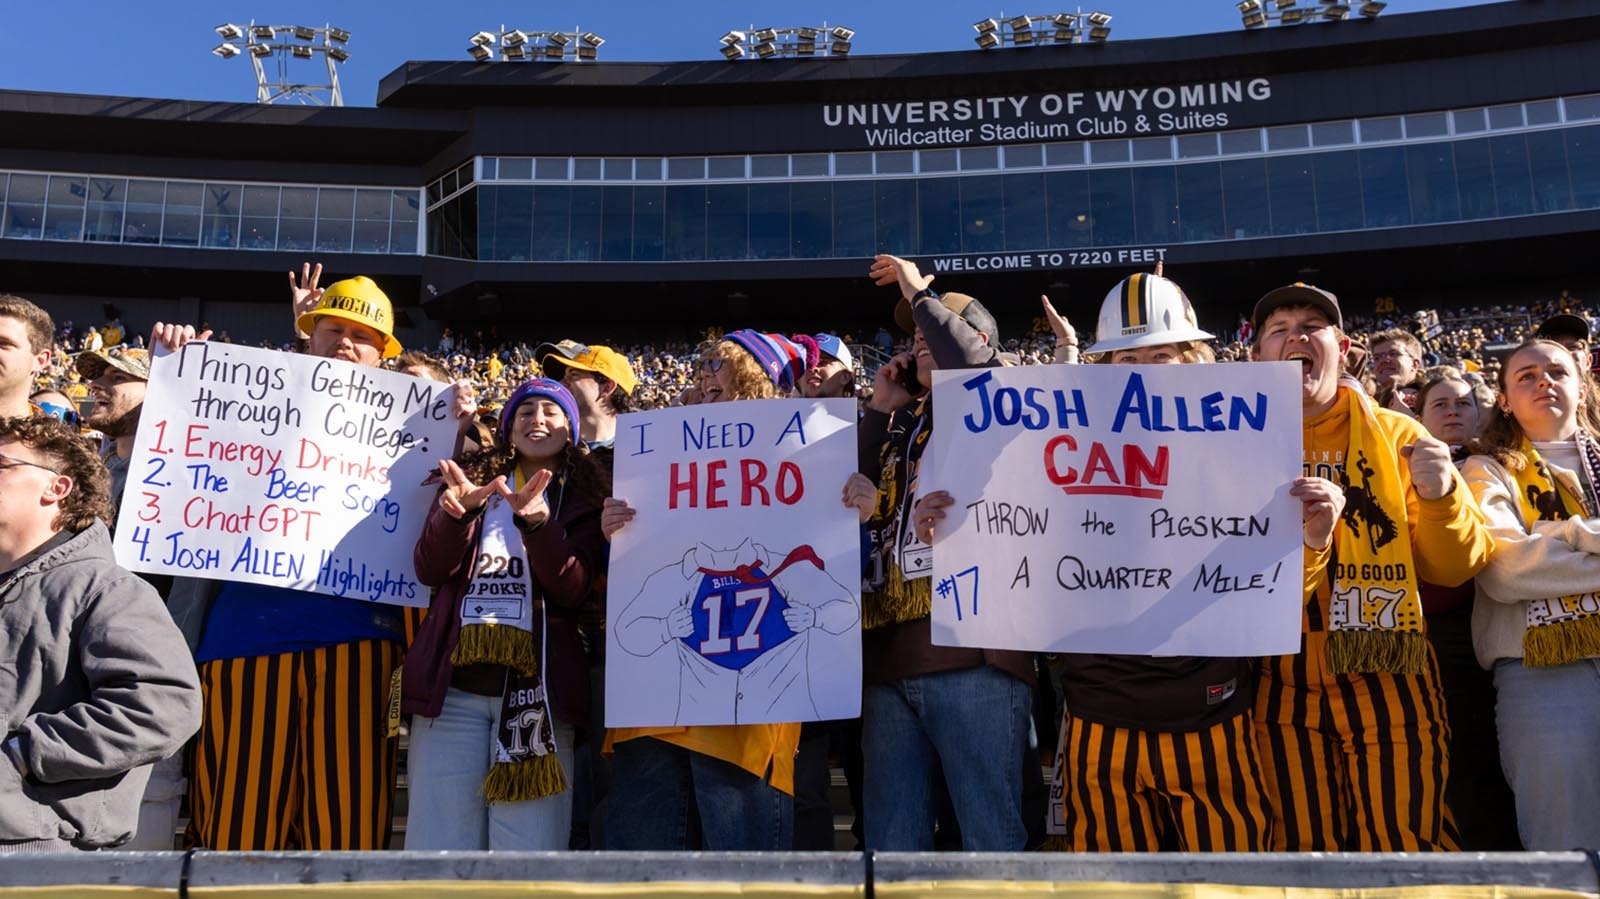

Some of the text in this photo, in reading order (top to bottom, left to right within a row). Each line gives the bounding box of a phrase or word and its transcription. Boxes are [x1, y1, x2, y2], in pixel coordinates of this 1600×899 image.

[823, 78, 1272, 126] UNIVERSITY OF WYOMING
[865, 112, 1229, 146] Wildcatter Stadium Club & Suites
[934, 249, 1168, 272] WELCOME TO 7220 FEET
[326, 296, 384, 323] WYOMING
[177, 341, 447, 421] Things Getting Me
[962, 370, 1268, 434] JOSH ALLEN
[192, 388, 430, 457] through College:
[631, 411, 807, 456] I NEED A
[148, 420, 391, 485] 1. Energy Drinks
[1043, 433, 1169, 488] CAN
[143, 458, 401, 533] 2. The Beer Song
[669, 458, 805, 510] HERO
[137, 491, 321, 541] 3. ChatGPT
[966, 499, 1270, 538] THROW the PIGSKIN
[131, 526, 417, 601] 4. JOSH ALLEN Highlights
[712, 576, 742, 589] BILLS
[1010, 555, 1283, 595] A QUARTER MILE!
[1336, 563, 1407, 581] DO GOOD
[477, 583, 527, 597] POKES
[935, 565, 980, 621] #17
[1336, 586, 1407, 629] 17
[700, 587, 770, 655] 17
[506, 706, 549, 756] 17
